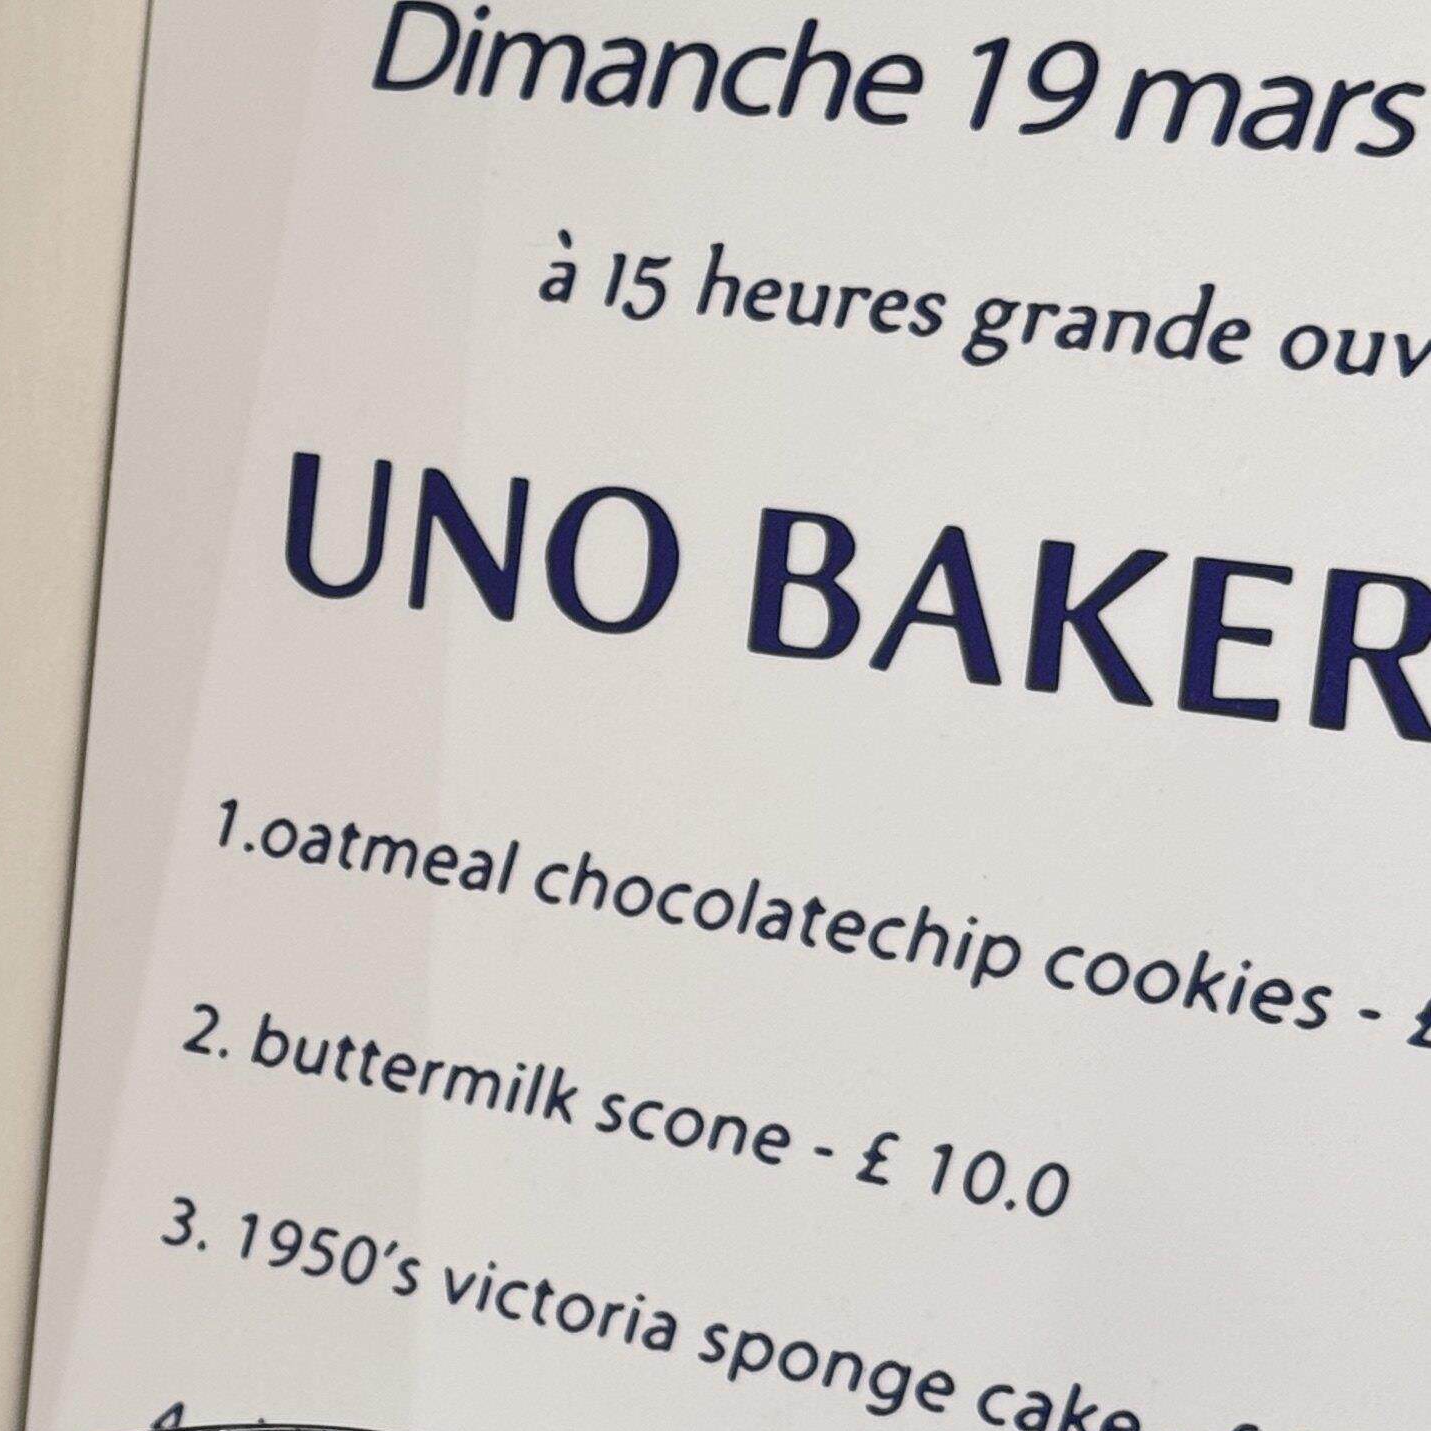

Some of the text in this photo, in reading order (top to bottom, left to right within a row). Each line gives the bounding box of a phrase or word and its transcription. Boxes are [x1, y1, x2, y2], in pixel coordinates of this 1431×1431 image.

[371, 0, 1428, 159] Dimanche 19 mars
[537, 227, 1431, 380] à 15 heures grande ouv
[283, 450, 1431, 744] UNO BAKER
[215, 797, 521, 895] 1.oatmeal
[533, 850, 1023, 990] chocolatechip
[1043, 944, 1334, 1031] cookies
[181, 1002, 230, 1060] 2.
[249, 1011, 579, 1126] buttermilk
[594, 1092, 792, 1167] scone
[855, 1130, 901, 1187] £
[930, 1142, 1071, 1219] 10.0
[160, 1195, 209, 1253] 3.
[443, 1259, 679, 1353] victoria
[697, 1321, 957, 1418] sponge
